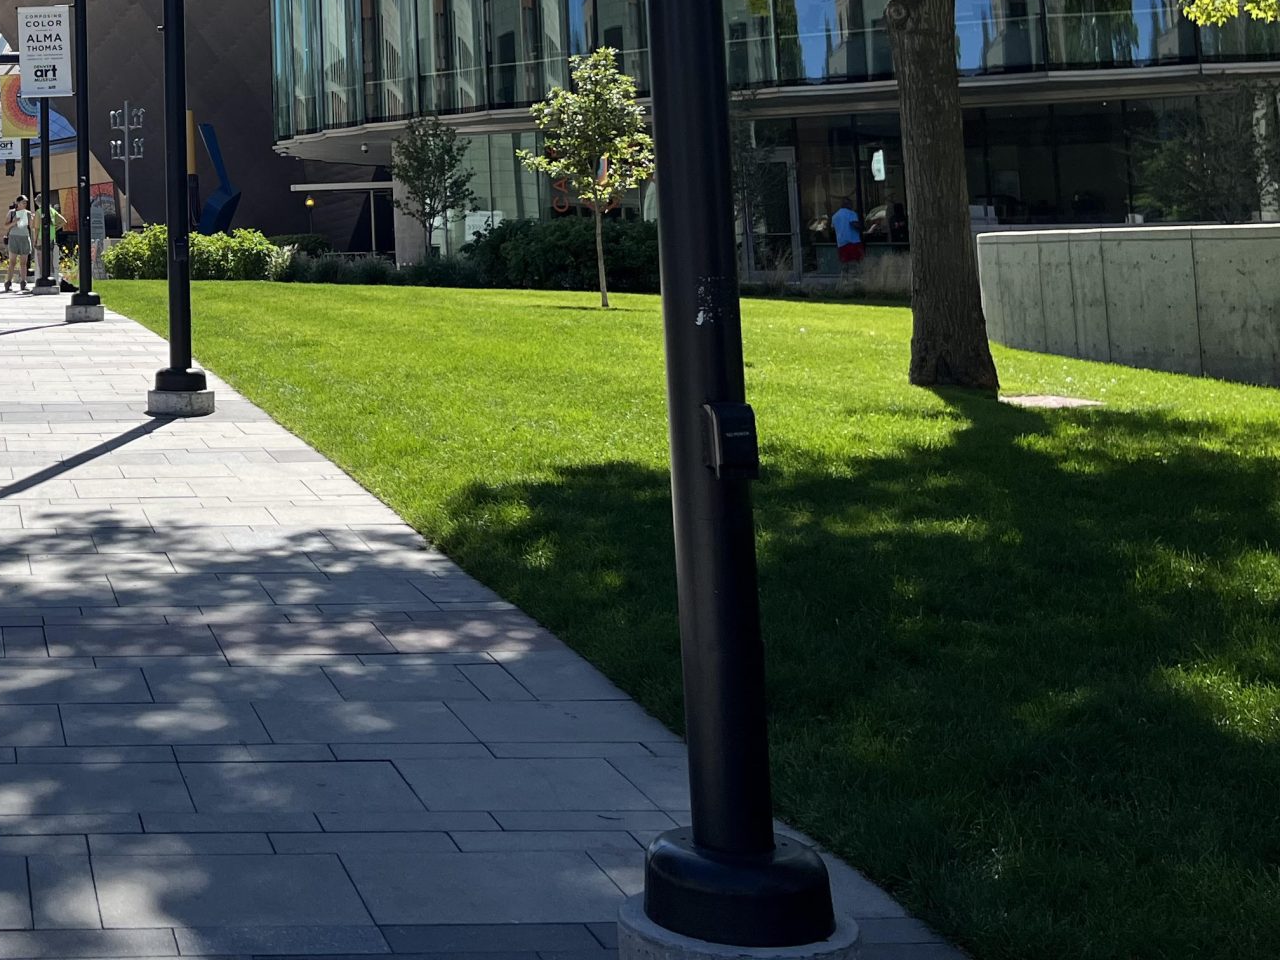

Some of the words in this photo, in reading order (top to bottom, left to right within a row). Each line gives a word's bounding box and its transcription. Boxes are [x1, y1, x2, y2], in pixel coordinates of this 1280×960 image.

[25, 20, 62, 28] COLOR
[26, 33, 62, 43] ALMA
[26, 44, 63, 52] THOMAS
[34, 64, 57, 78] art
